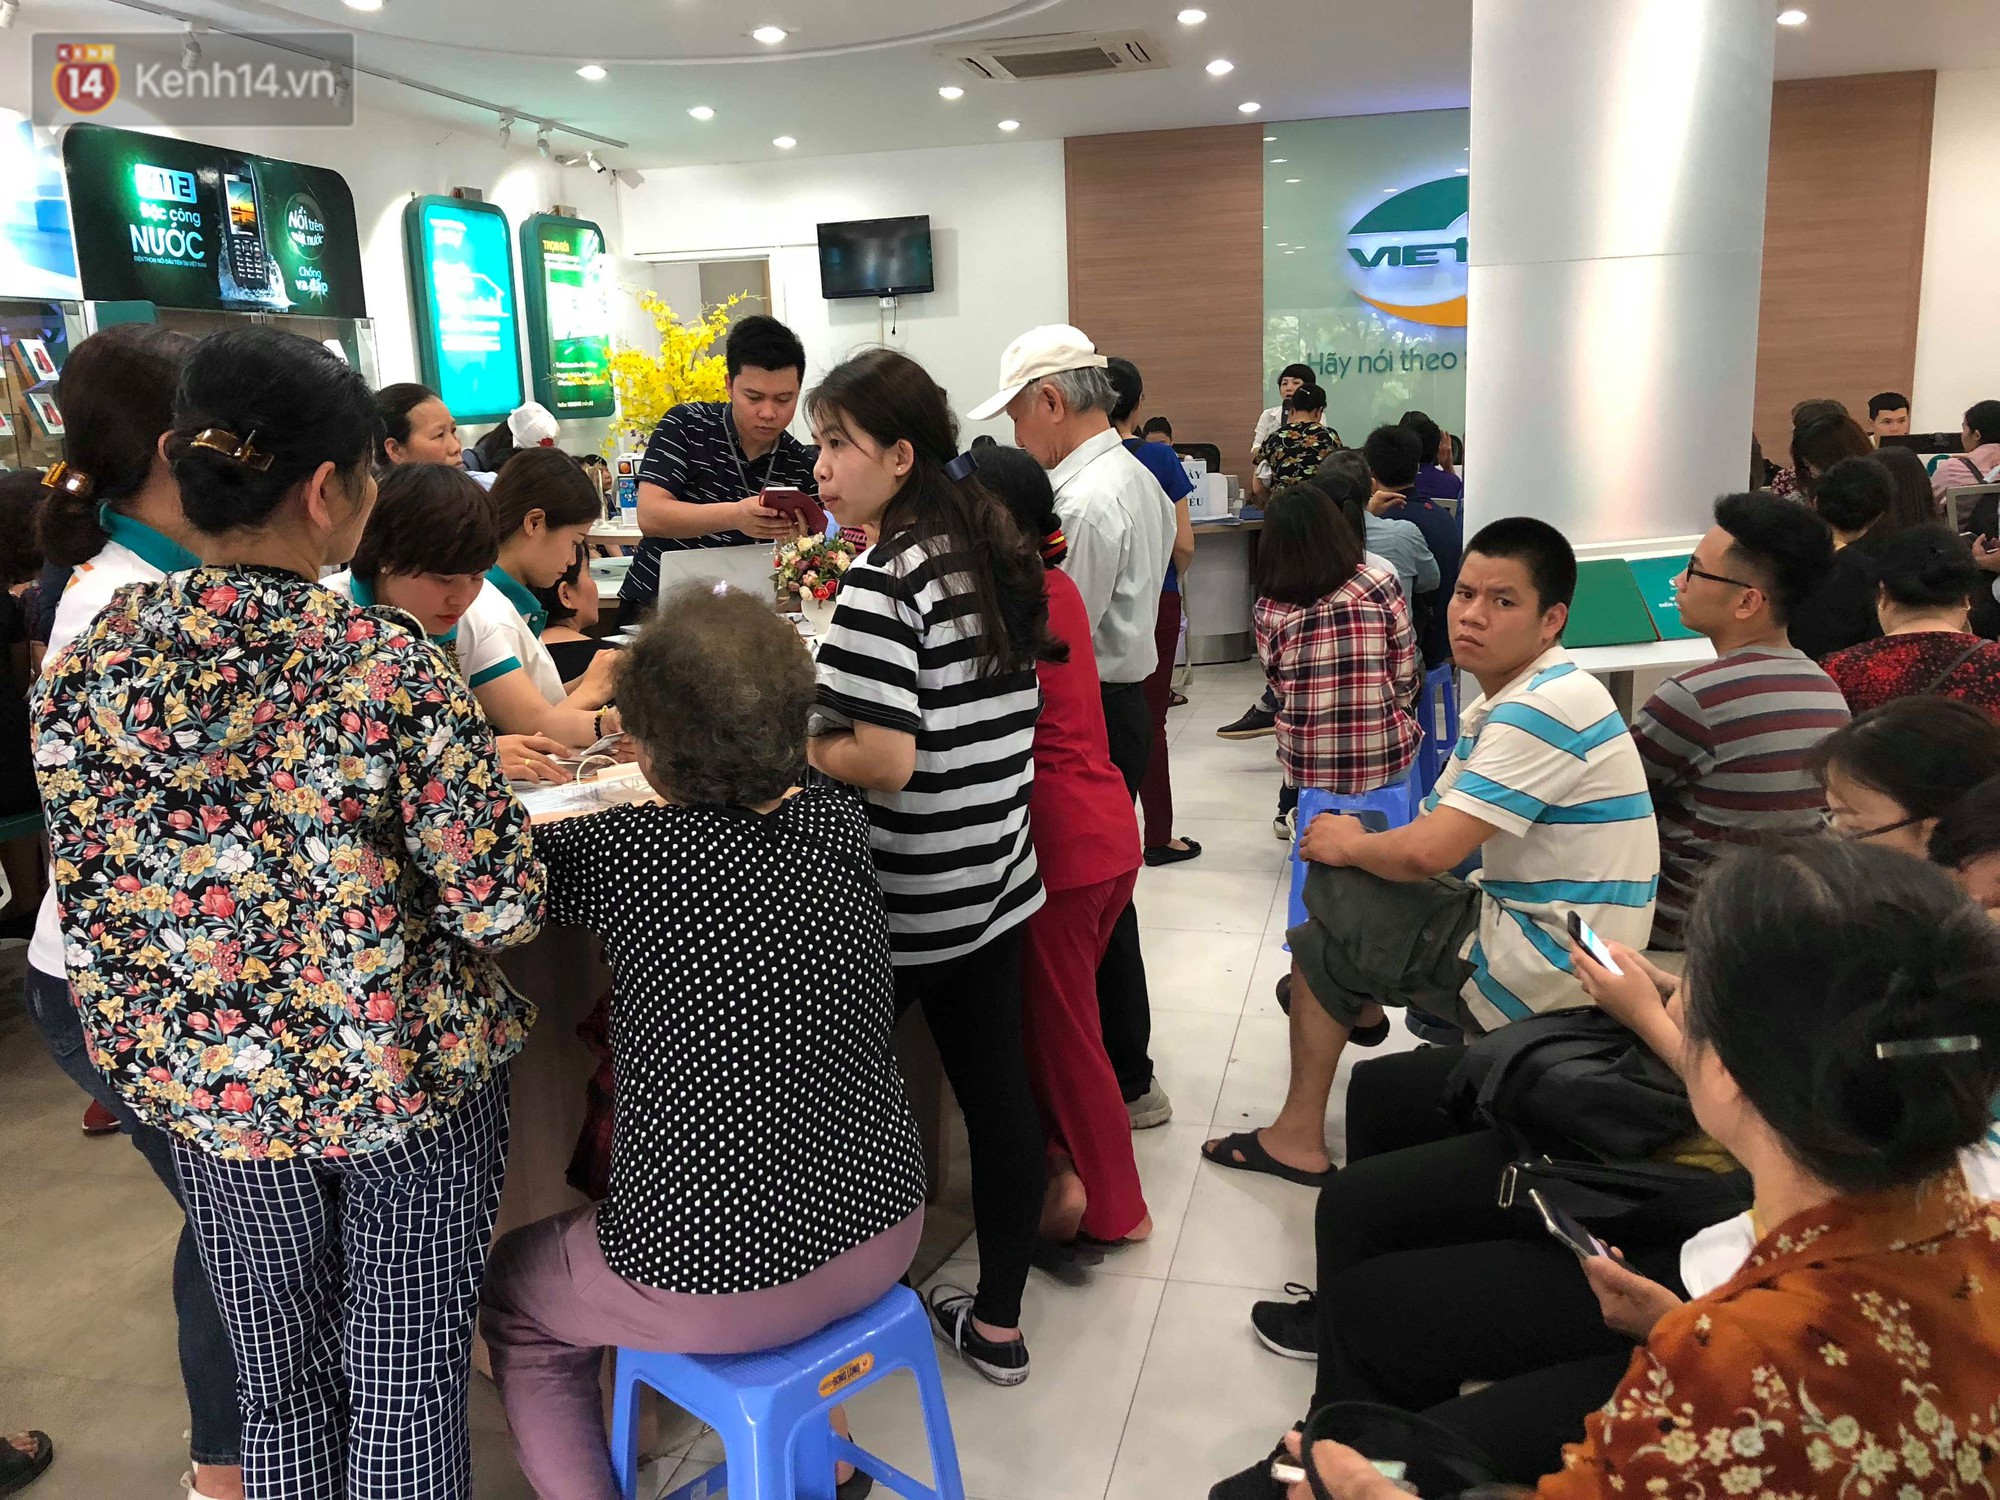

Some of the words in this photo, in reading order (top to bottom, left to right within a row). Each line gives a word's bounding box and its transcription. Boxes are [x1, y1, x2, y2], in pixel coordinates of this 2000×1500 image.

[169, 208, 201, 228] công
[129, 221, 205, 260] NƯỚC
[1347, 237, 1467, 268] VIET
[1308, 352, 1351, 379] Hãy
[1358, 348, 1393, 373] nói
[1400, 348, 1457, 371] theo
